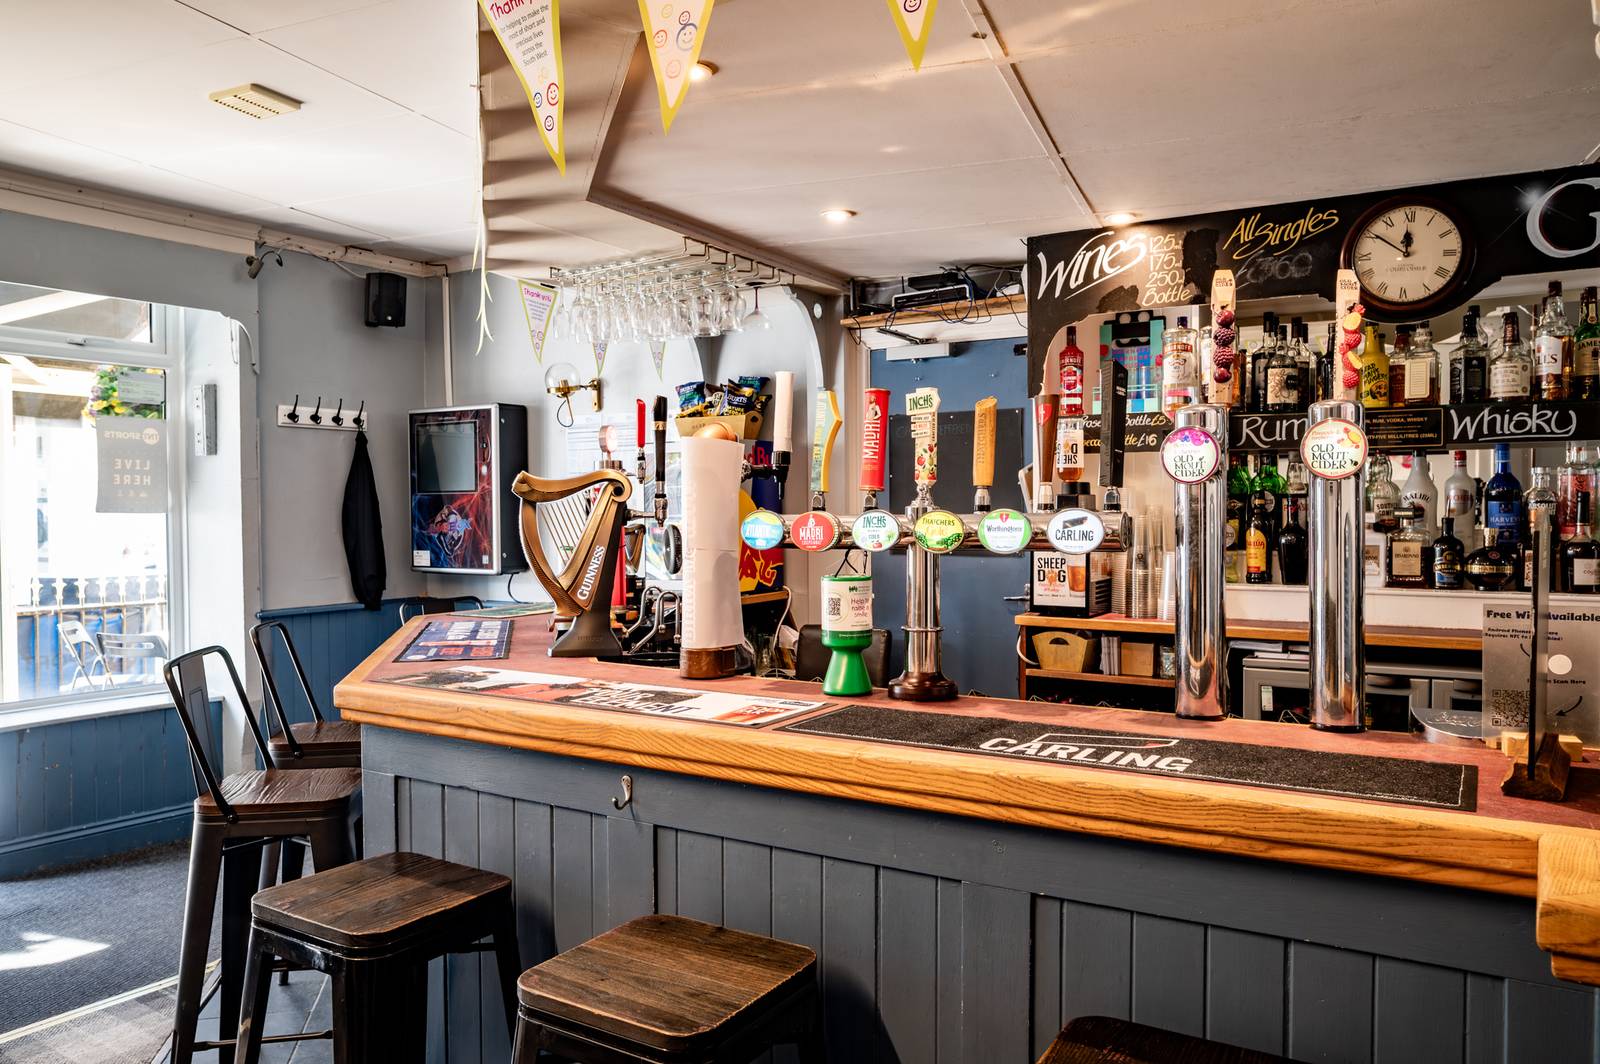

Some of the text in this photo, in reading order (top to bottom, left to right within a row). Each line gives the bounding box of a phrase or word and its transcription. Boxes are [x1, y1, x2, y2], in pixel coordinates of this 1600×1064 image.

[1222, 207, 1339, 259] All Singles
[1037, 231, 1148, 300] Wines
[1142, 285, 1193, 307] Bottle
[1450, 404, 1577, 441] Whisky
[1237, 416, 1307, 448] Rum
[1311, 444, 1335, 452] OLD
[1174, 454, 1194, 463] OLD
[1311, 461, 1347, 469] CIDER
[1174, 469, 1205, 477] CIDER
[1055, 529, 1094, 542] CARLING
[1037, 557, 1066, 569] SHEEP
[577, 545, 605, 600] GUINNESS
[1487, 610, 1512, 619] Free
[979, 738, 1193, 772] CARLING
